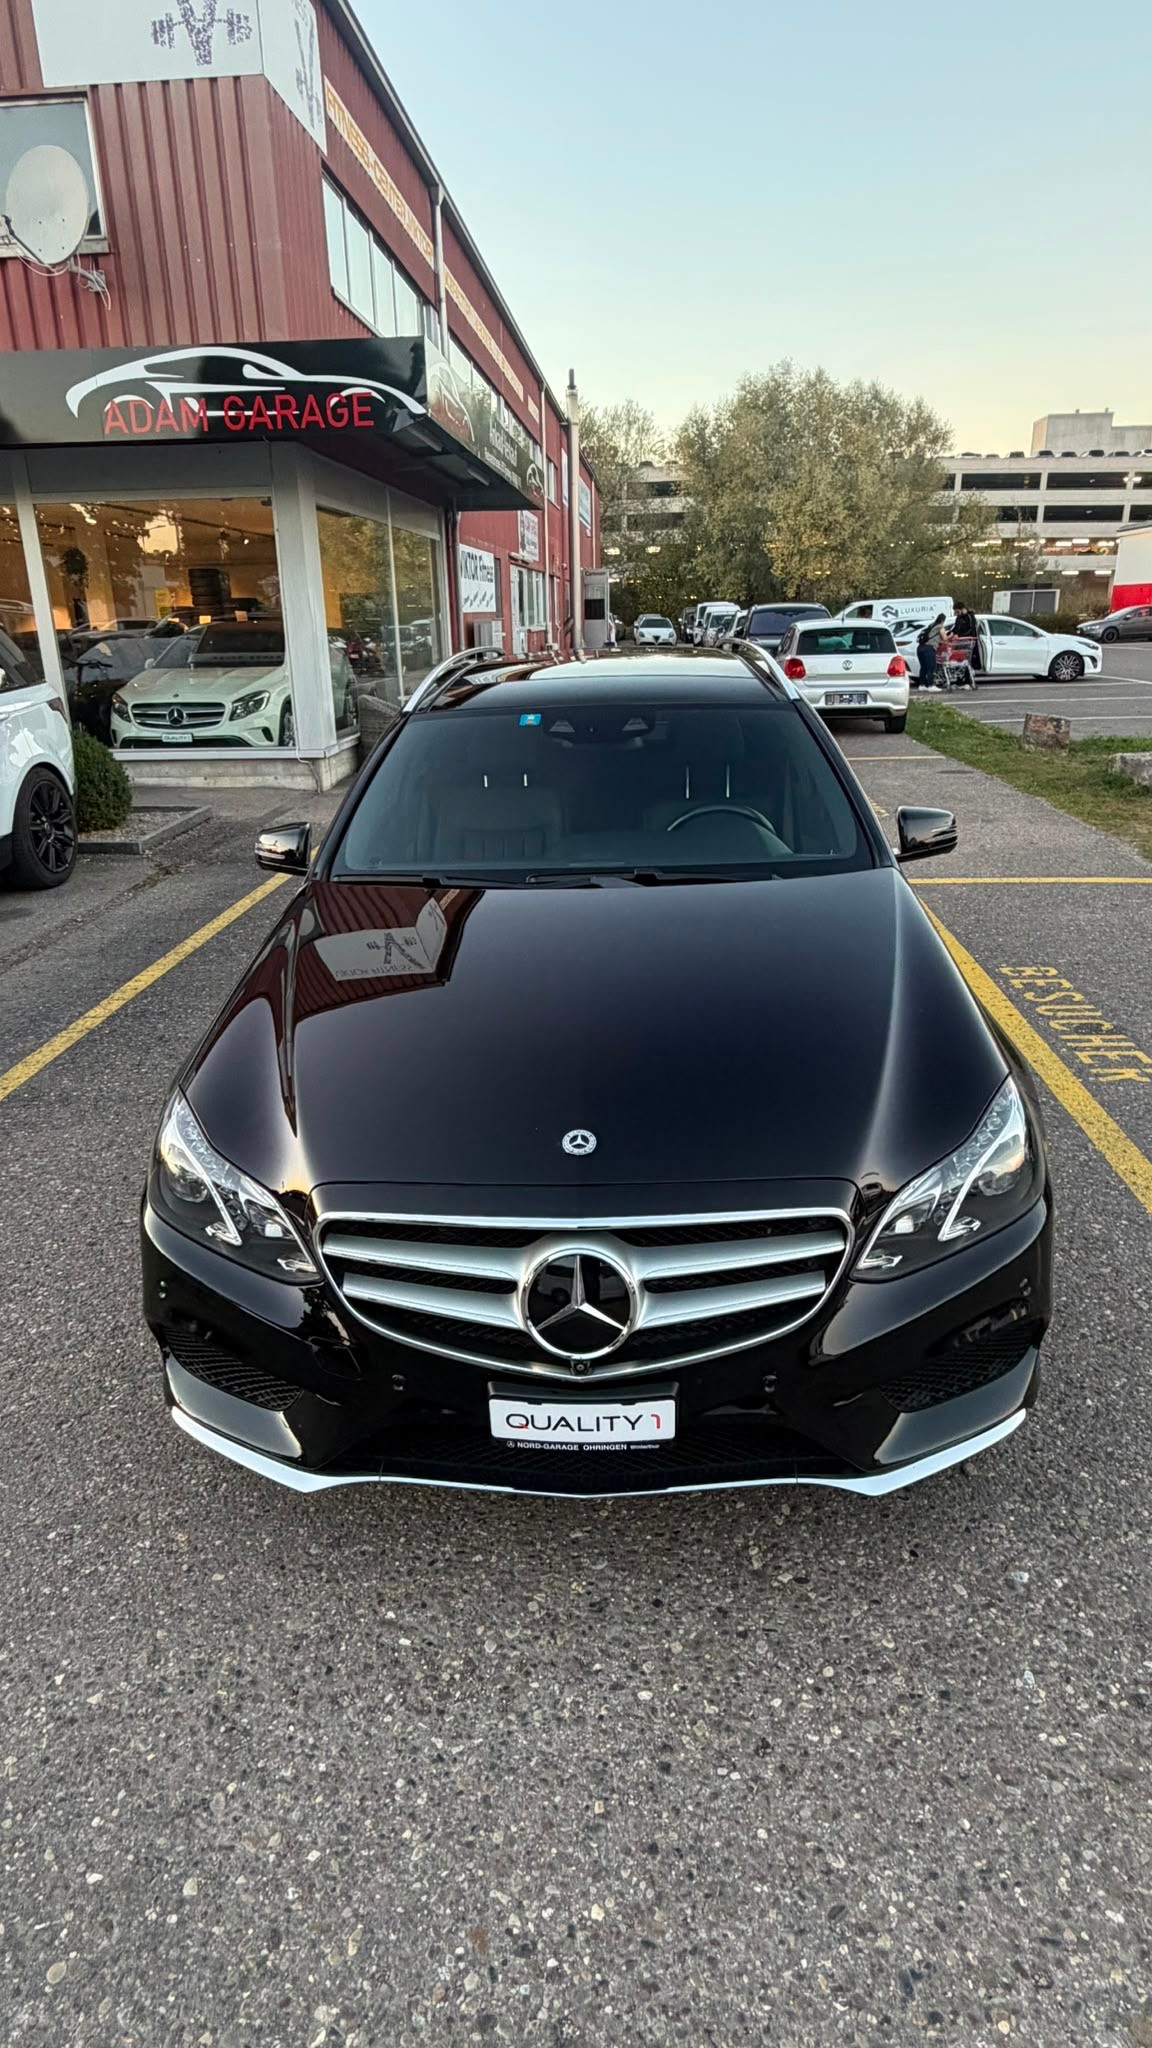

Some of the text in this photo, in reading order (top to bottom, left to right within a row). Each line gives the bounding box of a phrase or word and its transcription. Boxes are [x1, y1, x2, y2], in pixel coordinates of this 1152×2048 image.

[104, 391, 376, 435] ADAM GARAGE
[999, 966, 1152, 1083] BESUCHER
[505, 1413, 661, 1432] QUALITY 1
[517, 1442, 579, 1451] NORD-GARAGE
[583, 1443, 628, 1451] OHRINGEN
